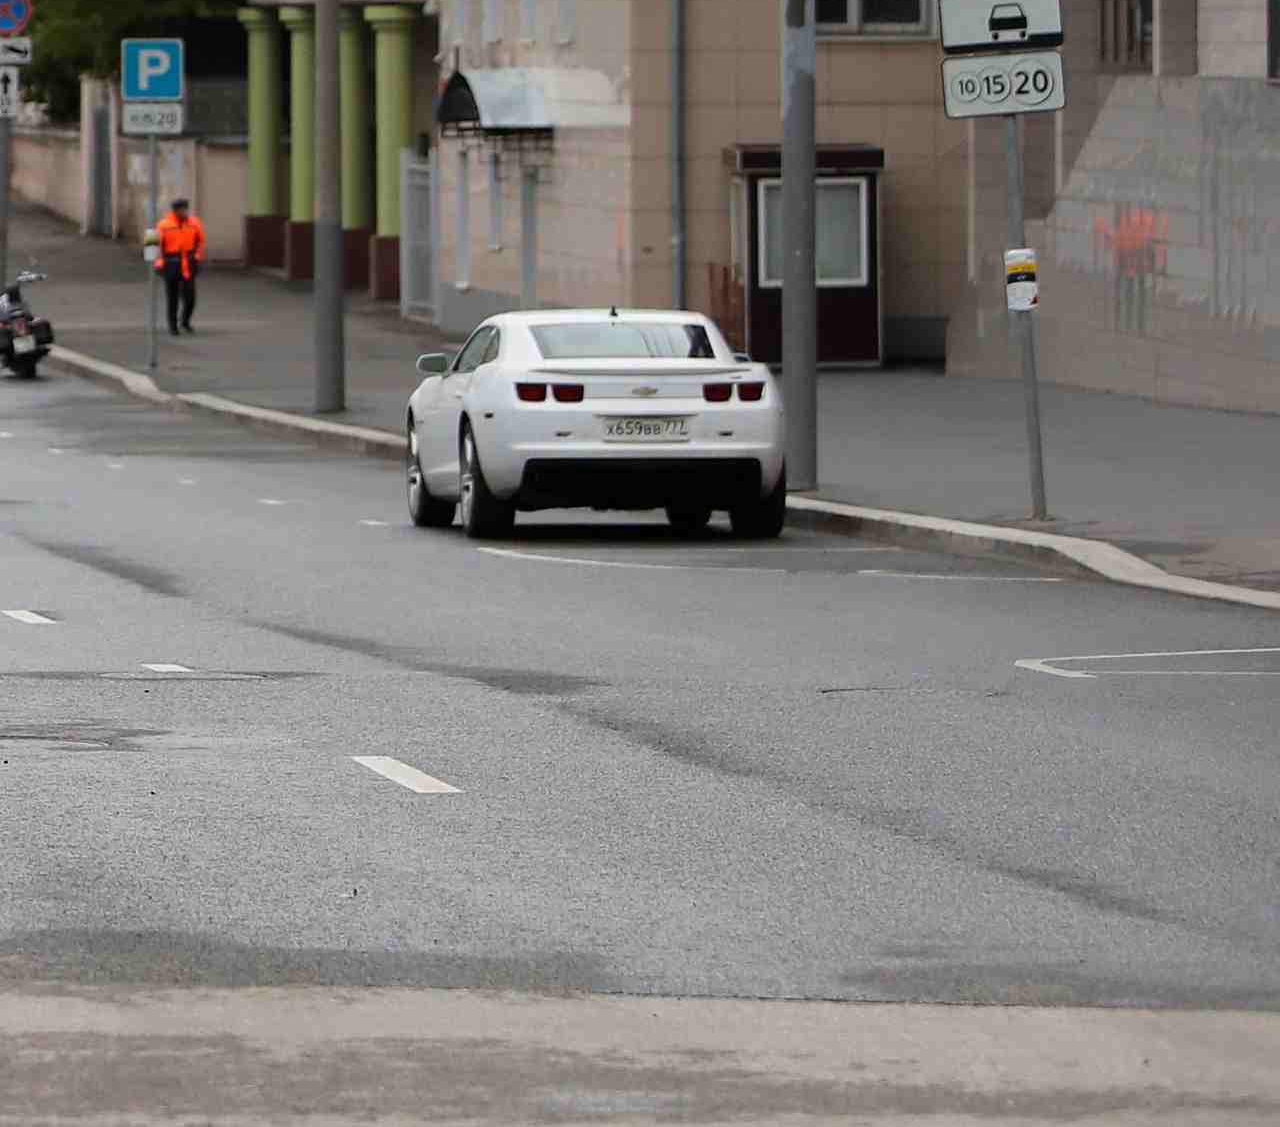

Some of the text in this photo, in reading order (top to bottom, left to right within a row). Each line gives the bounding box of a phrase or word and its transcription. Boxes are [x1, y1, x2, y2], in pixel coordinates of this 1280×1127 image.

[137, 49, 171, 90] P
[958, 70, 1049, 96] 10 15 20
